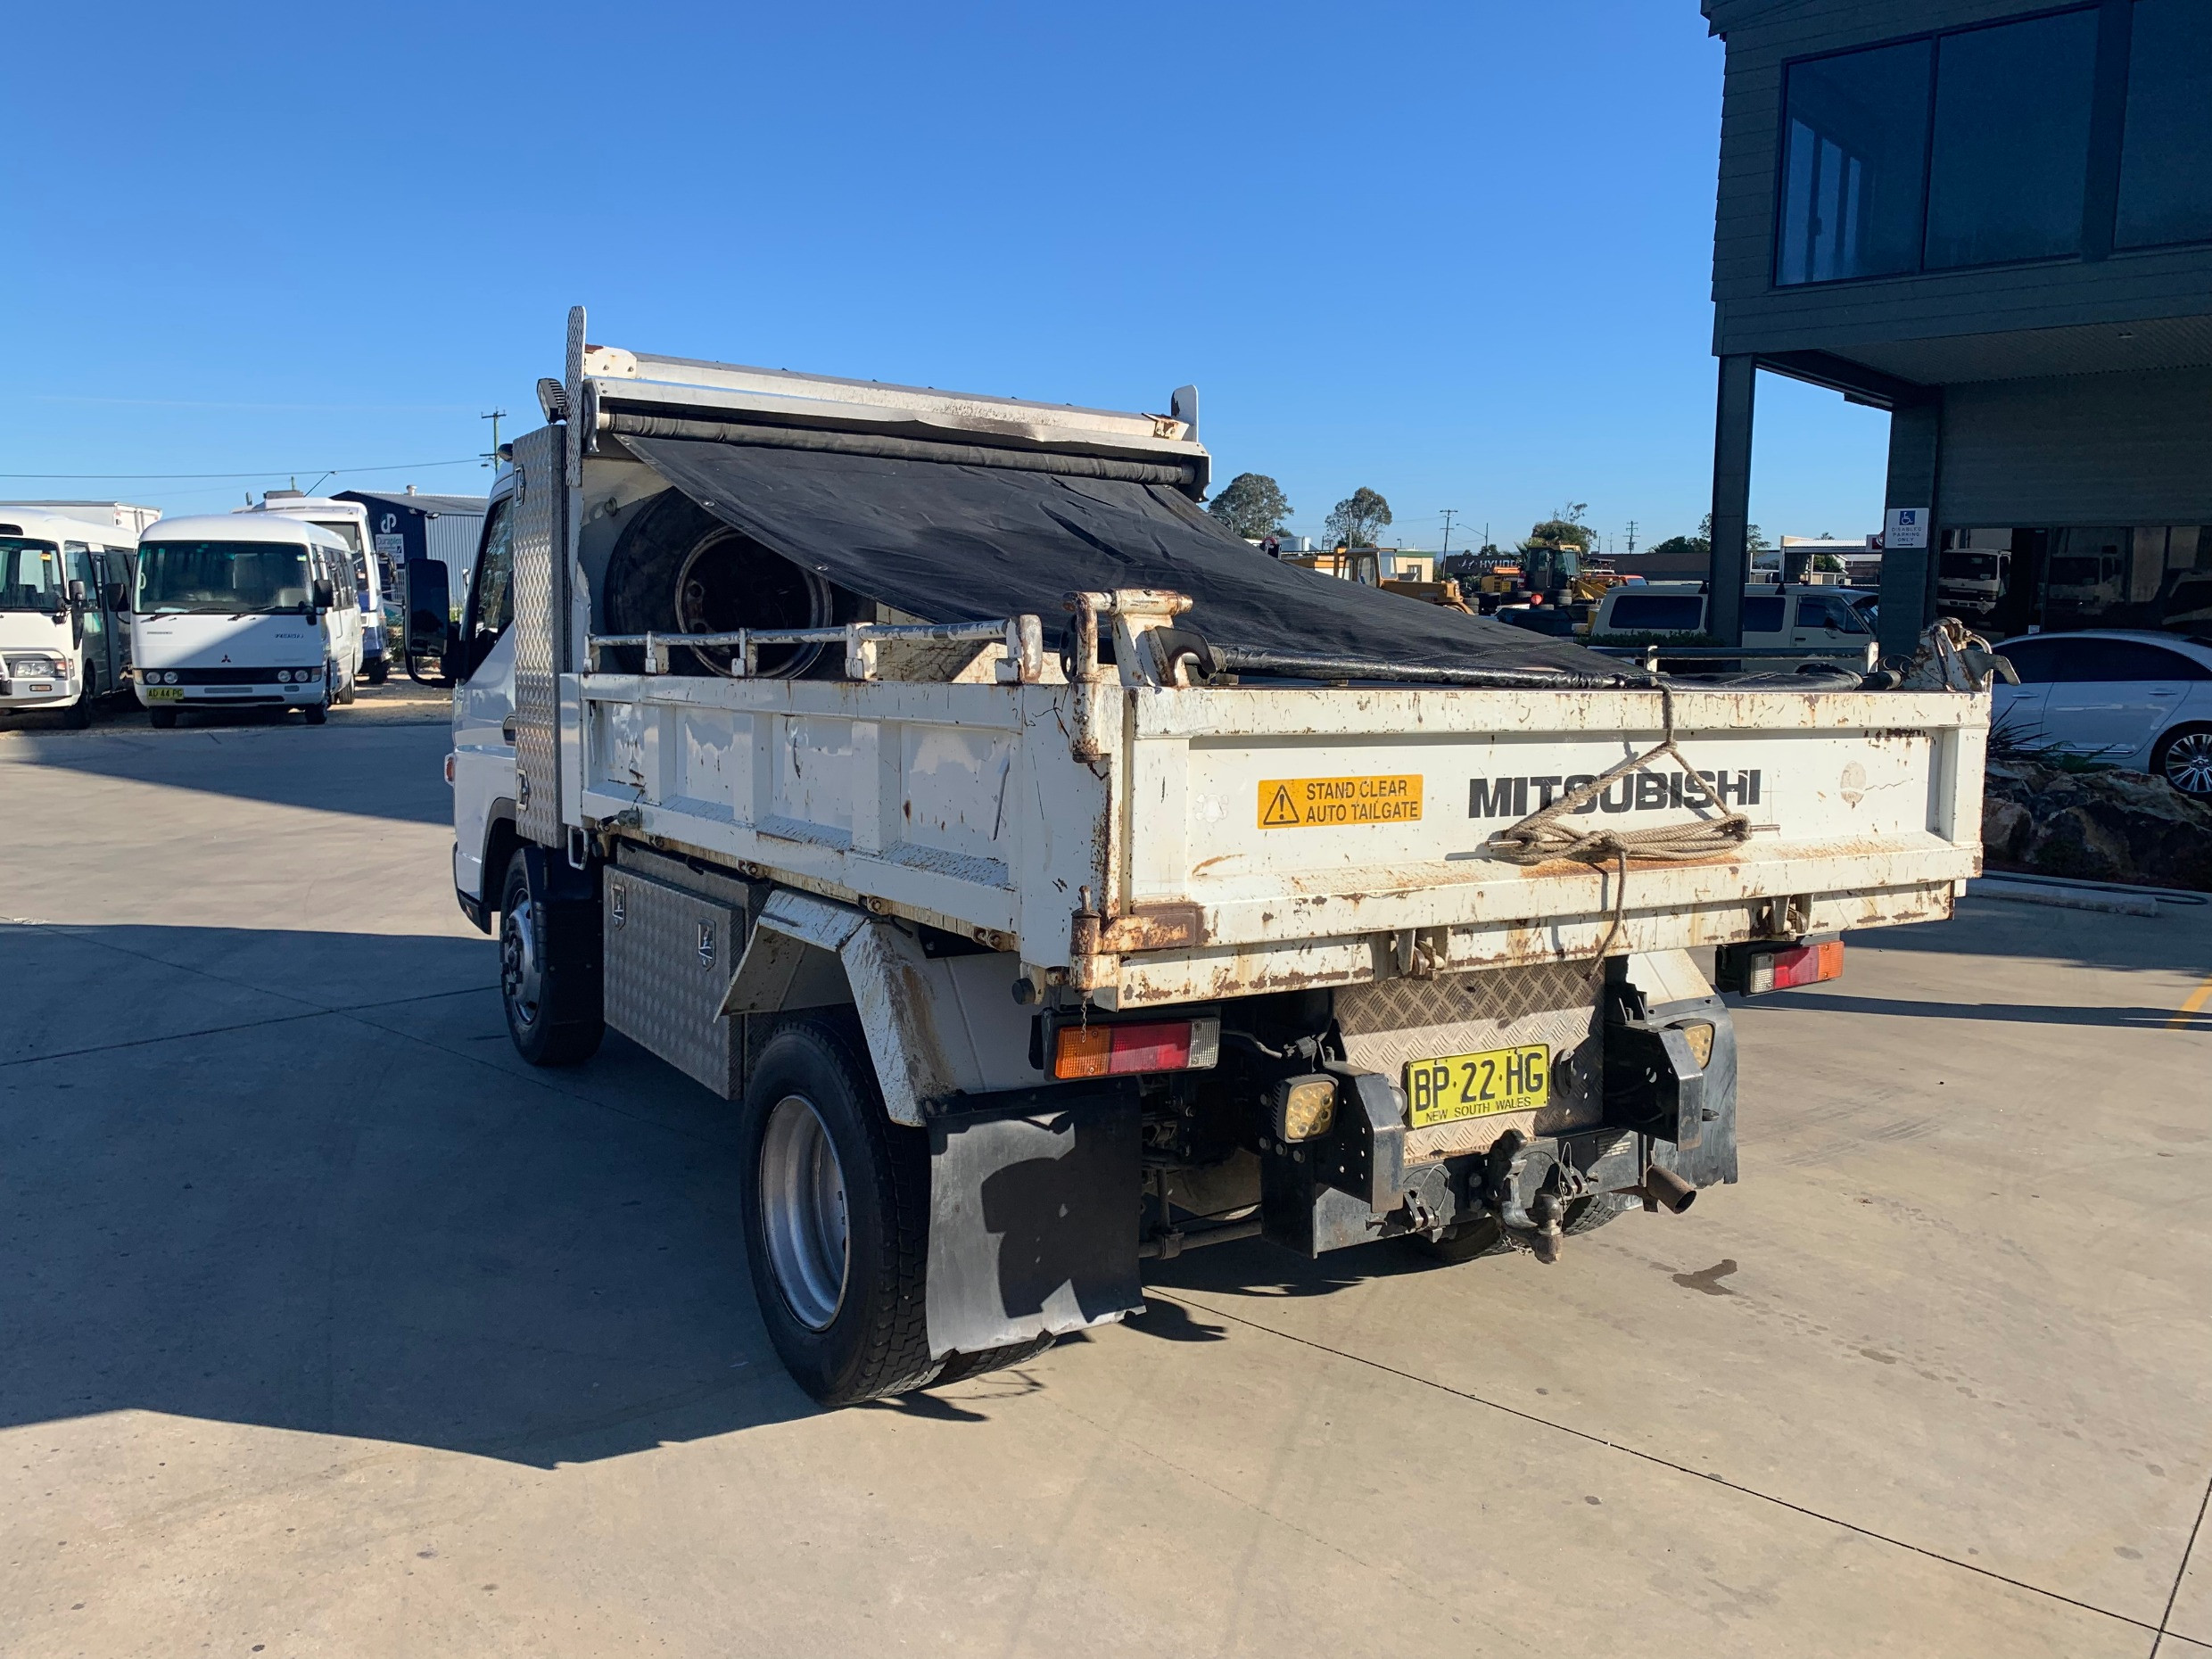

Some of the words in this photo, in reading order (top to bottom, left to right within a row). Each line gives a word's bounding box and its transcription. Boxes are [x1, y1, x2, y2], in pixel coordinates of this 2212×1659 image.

[1480, 559, 1518, 568] HYUND
[1306, 781, 1355, 800] STAND
[1359, 780, 1407, 798] CLEAR
[1468, 769, 1761, 818] MITSUBISHI
[1306, 804, 1347, 822] AUTO
[1351, 801, 1418, 820] TAILGATE
[1426, 1109, 1449, 1123] NEW
[1455, 1102, 1490, 1117] SOUTH
[1496, 1096, 1531, 1110] WALES
